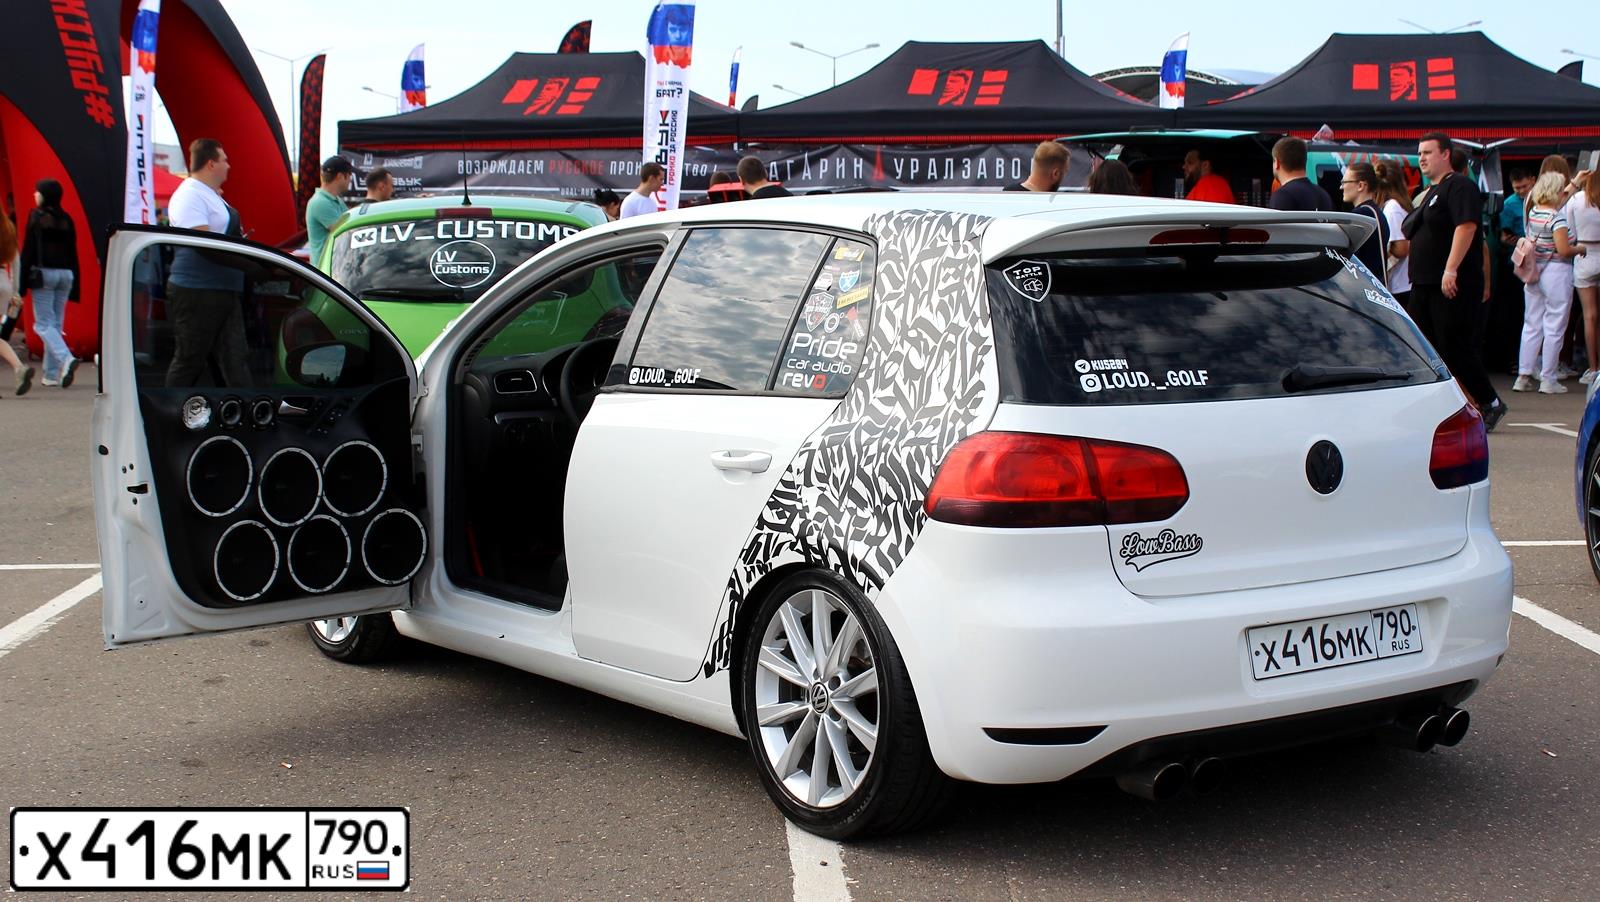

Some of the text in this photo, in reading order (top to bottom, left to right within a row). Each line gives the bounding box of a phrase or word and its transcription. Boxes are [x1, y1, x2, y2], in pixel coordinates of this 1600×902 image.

[656, 87, 682, 98] БРАТ?
[457, 160, 544, 175] ВОЗРОЖДАЕМ
[550, 159, 605, 175] РУССКОЕ
[893, 157, 1034, 180] УРАЛЗАВО
[436, 250, 457, 262] LV
[435, 265, 490, 274] Customs
[1013, 266, 1041, 276] TOP
[790, 332, 858, 360] Pride
[786, 358, 852, 375] car audio
[782, 372, 827, 390] revo
[1101, 370, 1208, 390] LOUD._.GOLF
[1120, 529, 1200, 558] LowBass
[1373, 609, 1412, 641] 790
[1391, 639, 1410, 651] RUS
